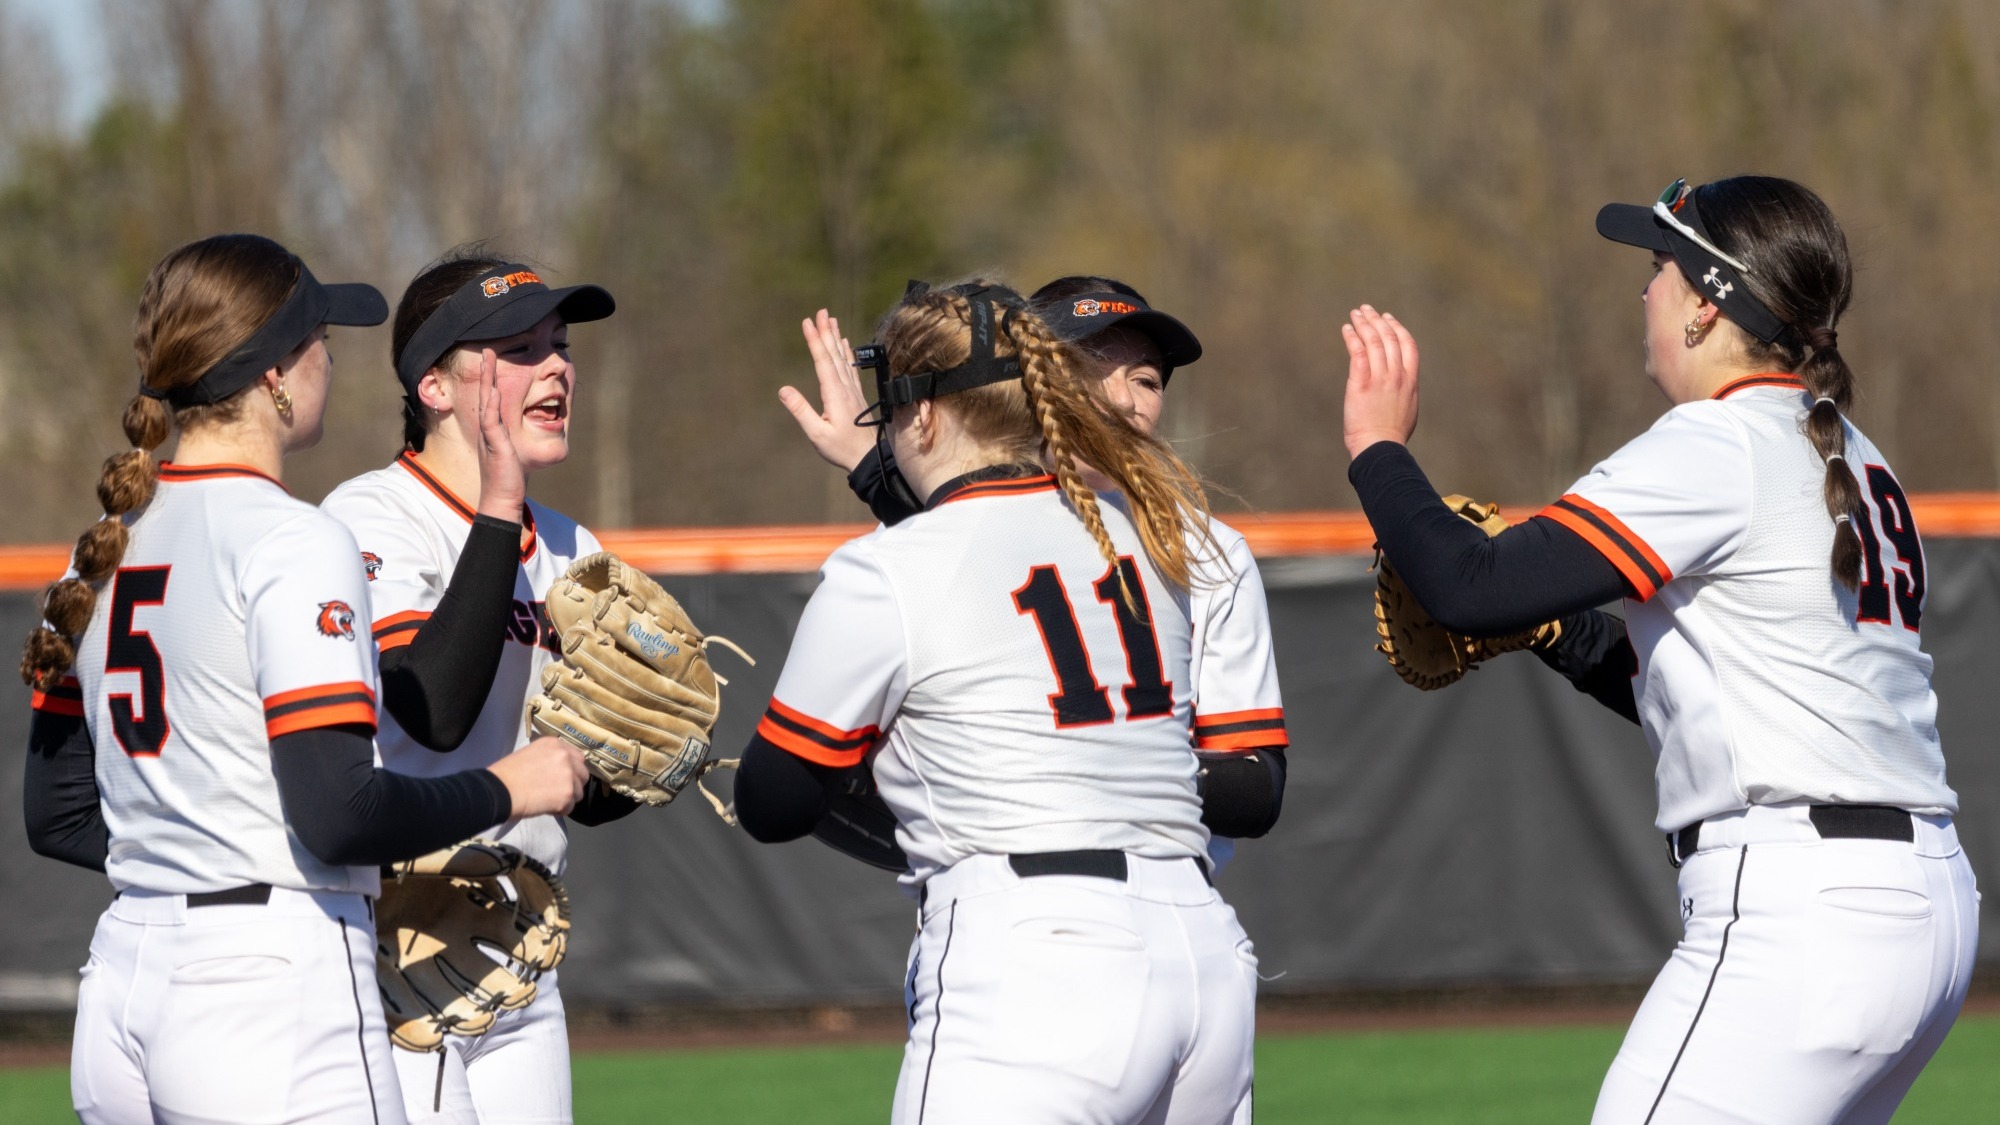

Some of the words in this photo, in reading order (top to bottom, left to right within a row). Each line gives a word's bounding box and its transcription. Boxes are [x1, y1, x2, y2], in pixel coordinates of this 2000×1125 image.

[1856, 463, 1926, 633] 19
[104, 564, 172, 758] 5
[626, 621, 679, 660] Rawlings
[1010, 554, 1175, 730] 11
